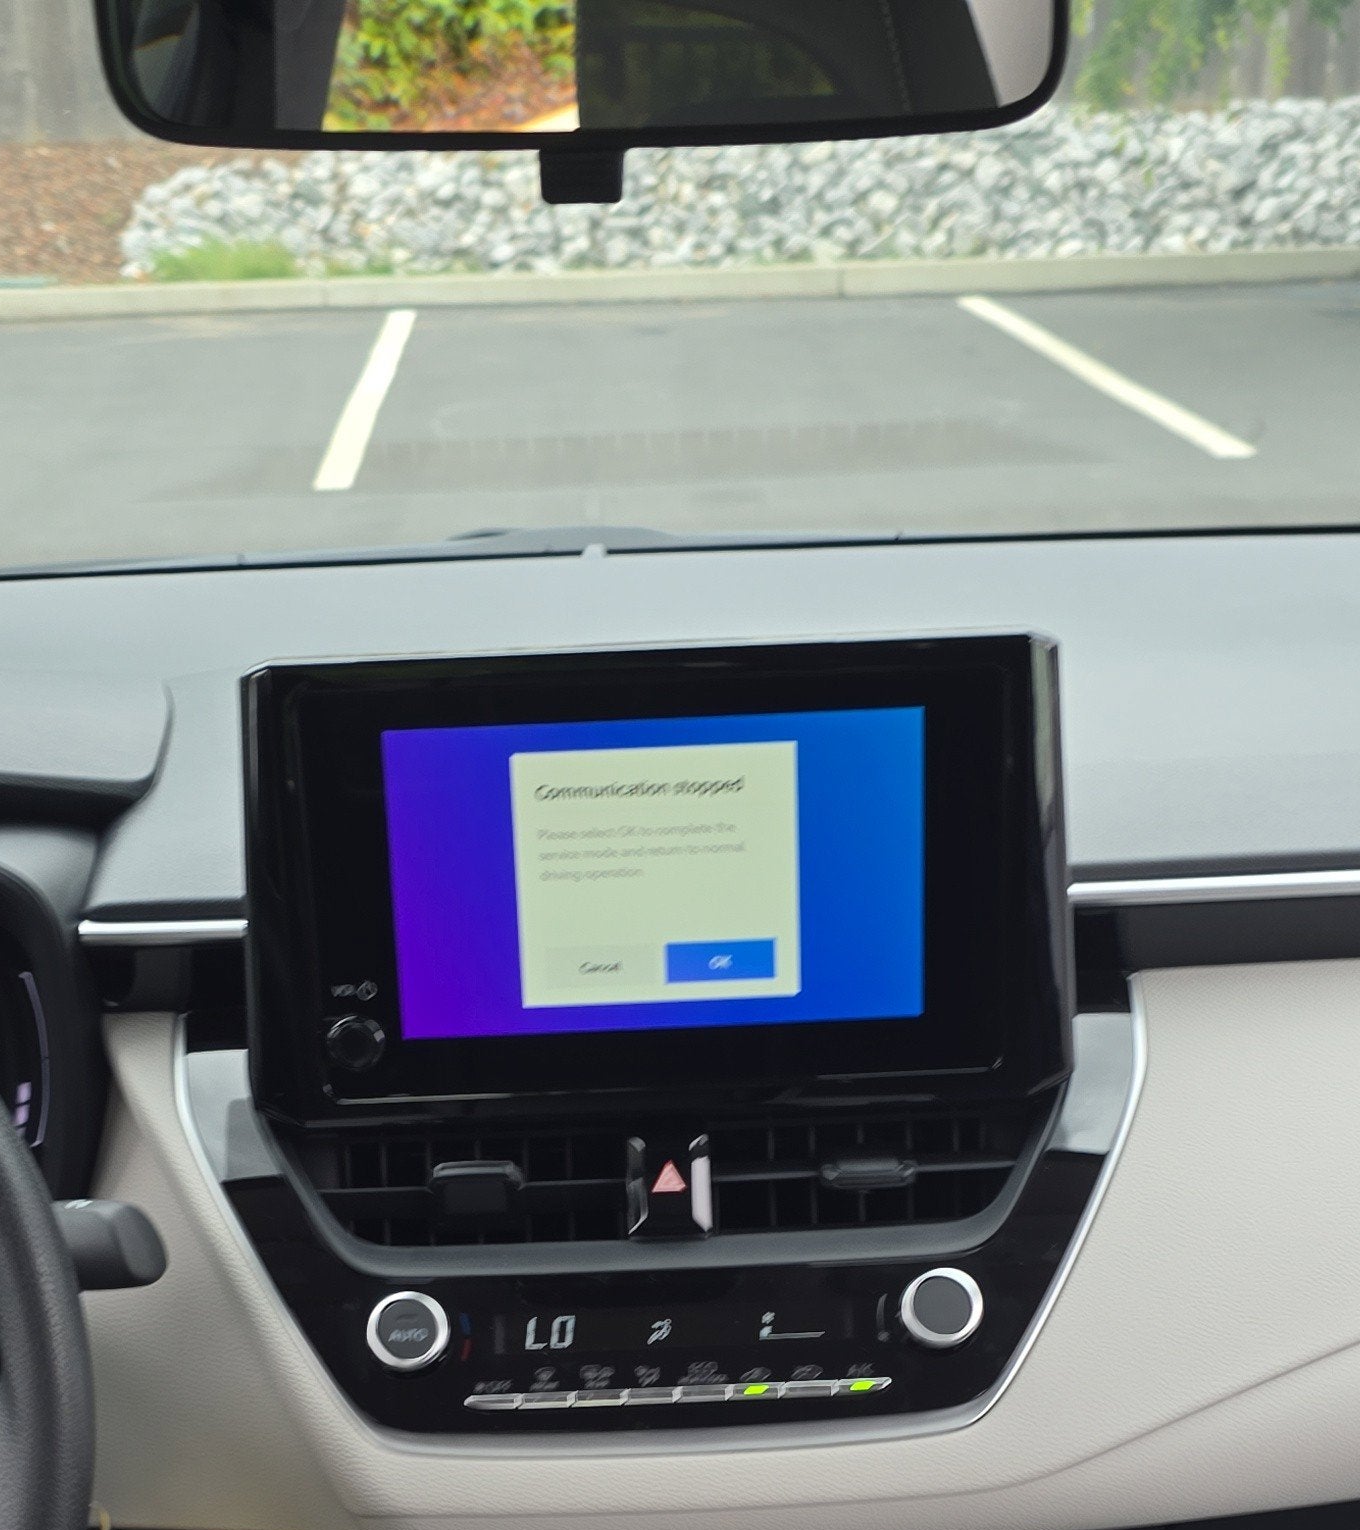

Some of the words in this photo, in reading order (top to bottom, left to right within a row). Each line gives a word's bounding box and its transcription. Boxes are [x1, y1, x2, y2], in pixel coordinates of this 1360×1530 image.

[534, 779, 669, 801] Communication
[672, 775, 746, 799] stopped
[387, 1328, 429, 1343] AUTO
[525, 1315, 576, 1351] LO
